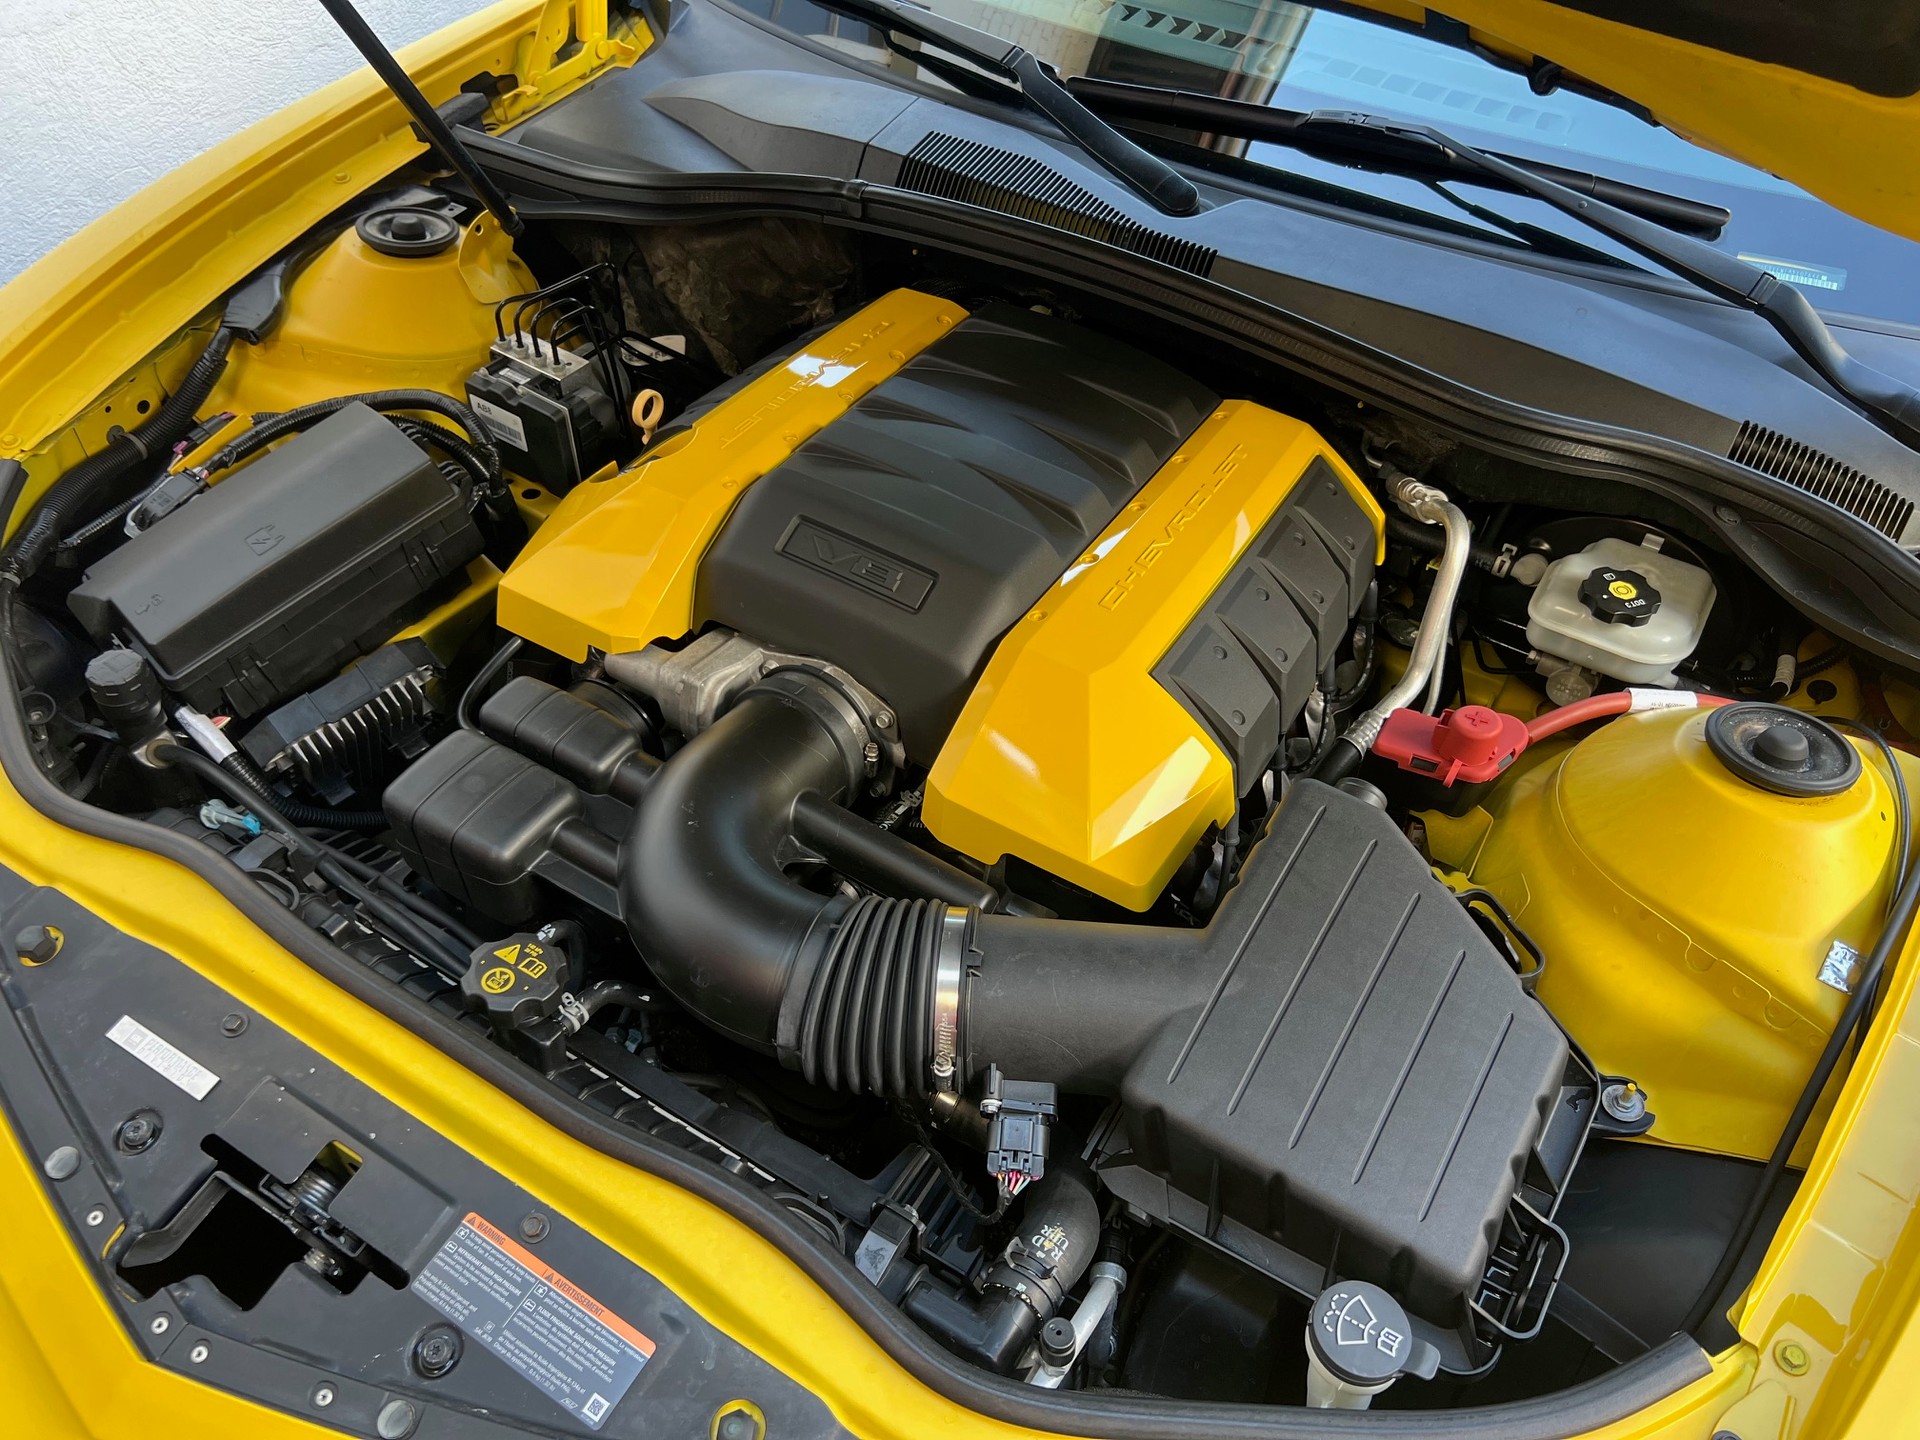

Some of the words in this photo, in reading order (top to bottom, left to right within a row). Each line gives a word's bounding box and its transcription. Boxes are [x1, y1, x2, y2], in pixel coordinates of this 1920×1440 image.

[1097, 443, 1249, 612] CHEVROLET
[812, 534, 904, 593] V8
[476, 1222, 505, 1245] WARNING
[553, 1277, 605, 1317] AVERTISSEMENT
